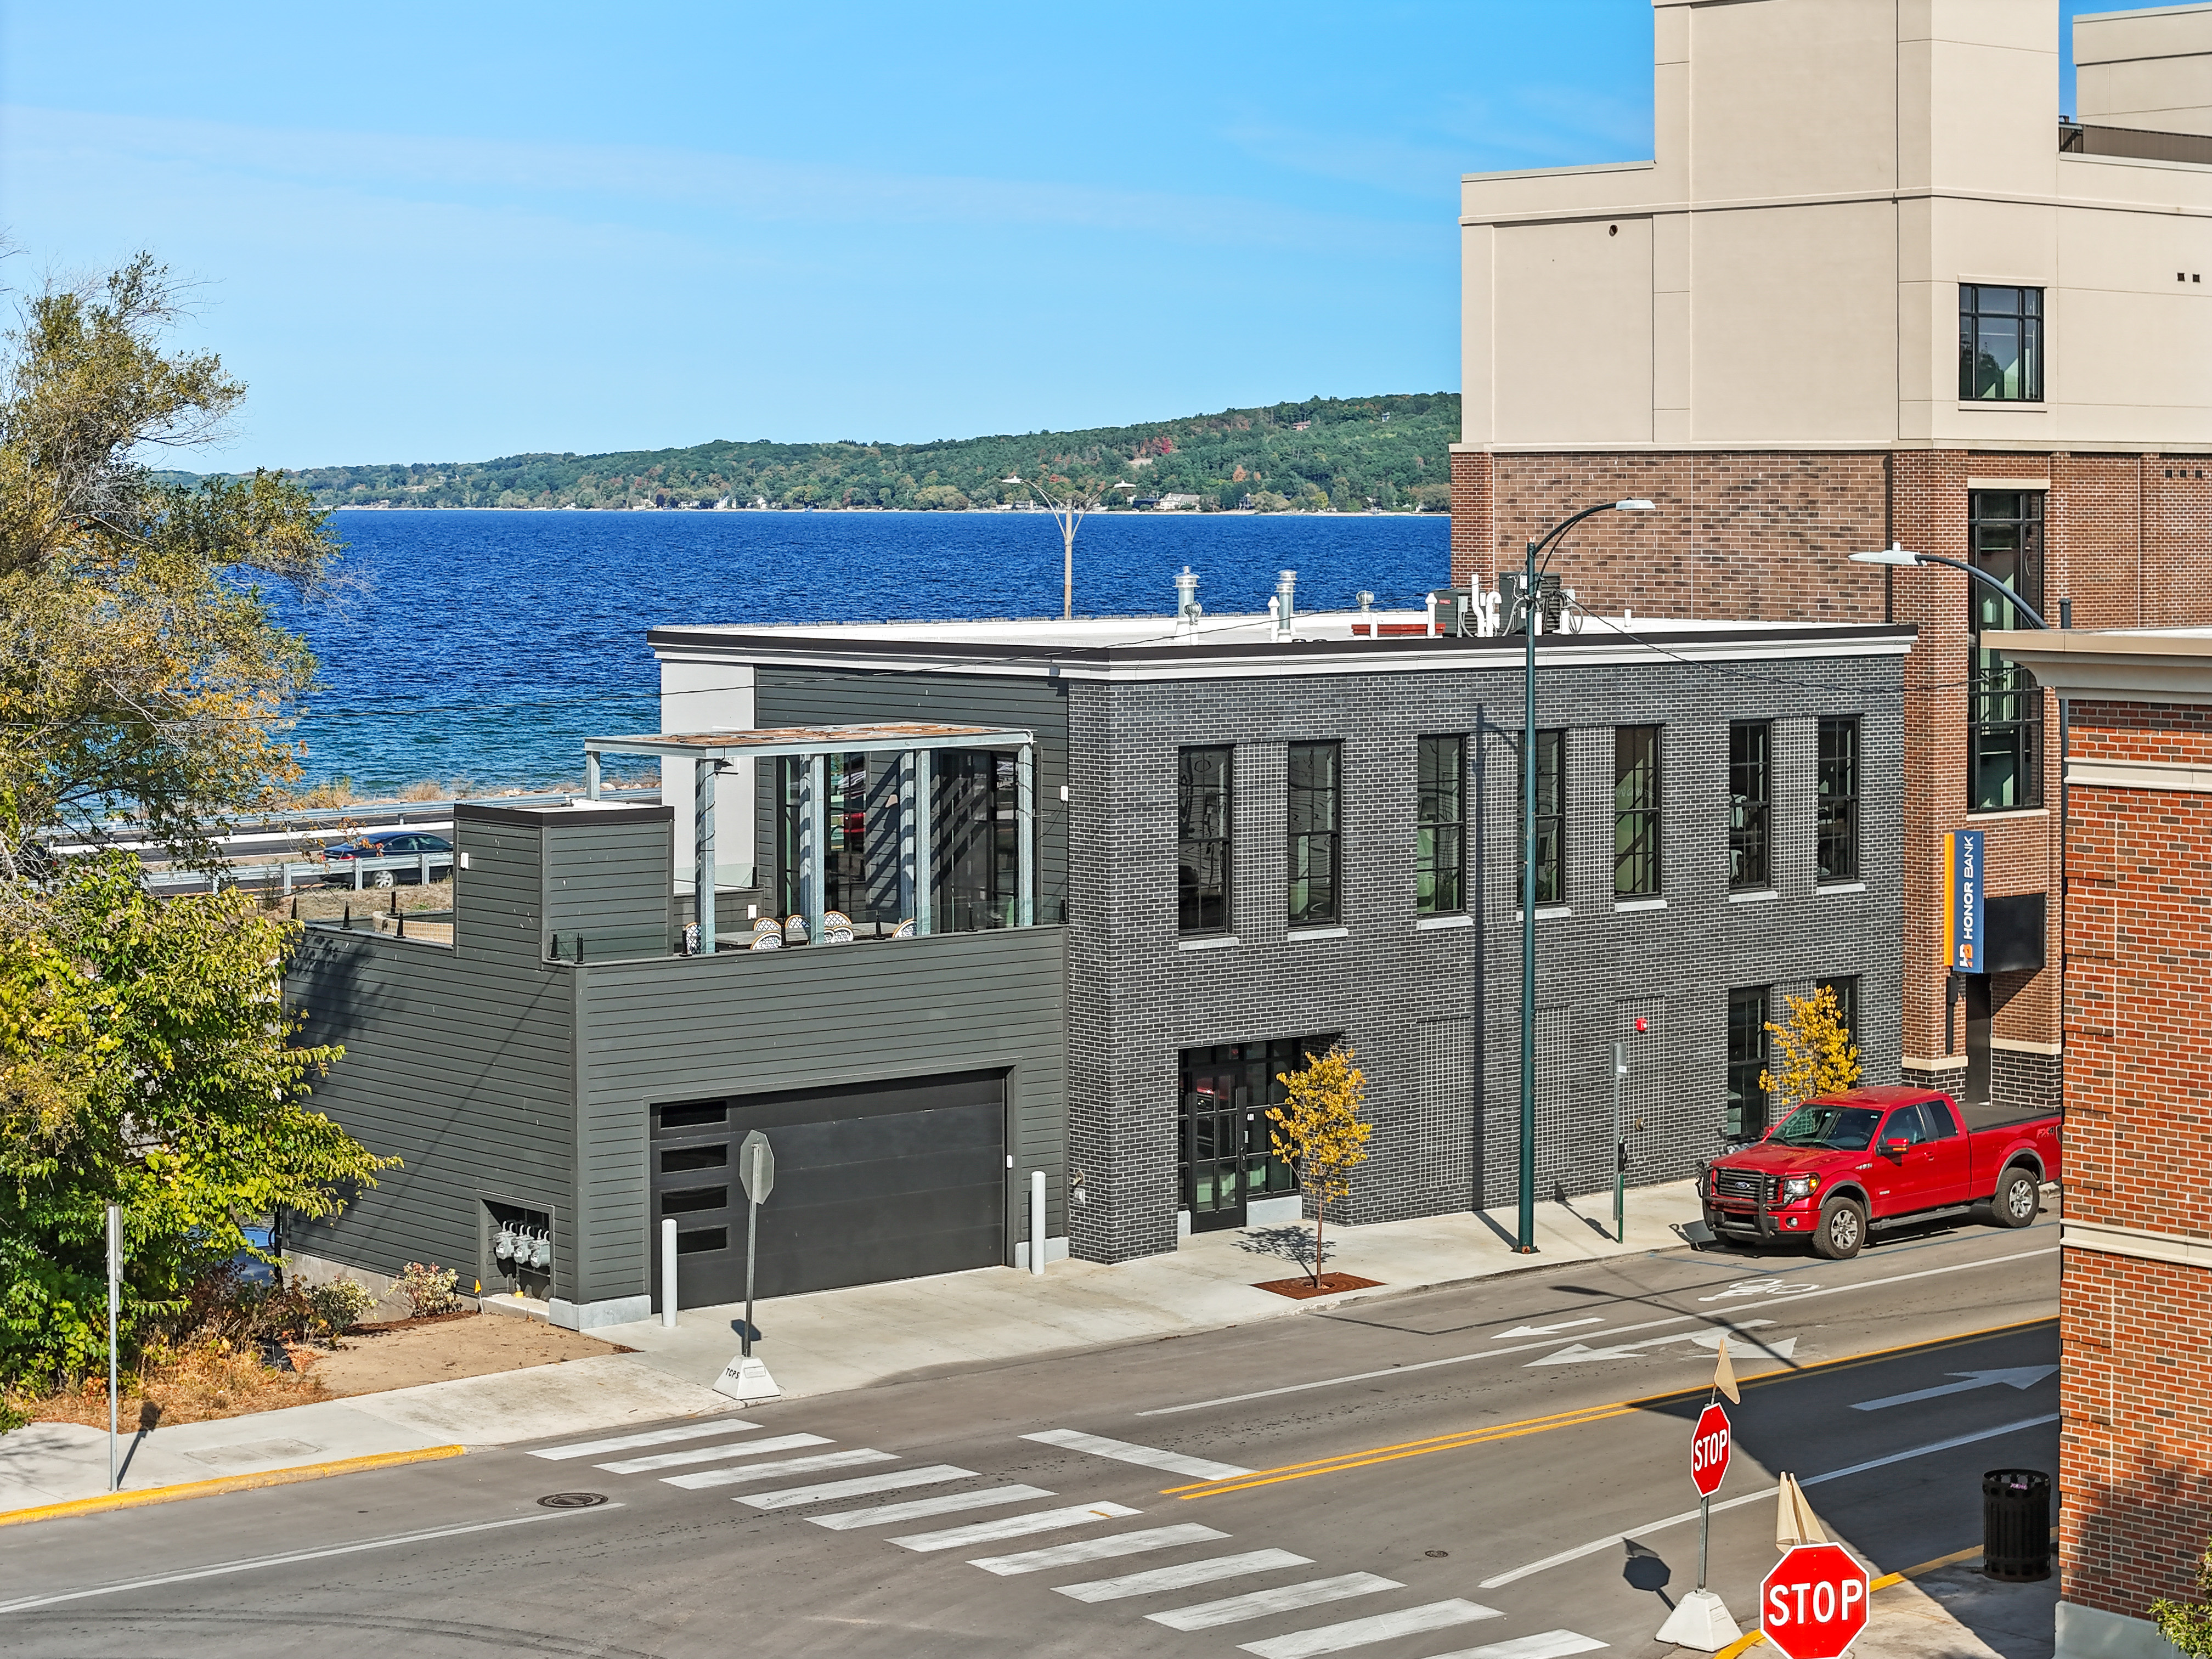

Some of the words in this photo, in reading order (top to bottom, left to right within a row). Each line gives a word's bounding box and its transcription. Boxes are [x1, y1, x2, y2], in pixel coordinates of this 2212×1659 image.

[1964, 835, 1974, 878] BANK
[1963, 881, 1973, 940] HONOR
[725, 1368, 740, 1379] TCPS
[1694, 1429, 1728, 1471] STOP
[1768, 1579, 1863, 1627] STOP
